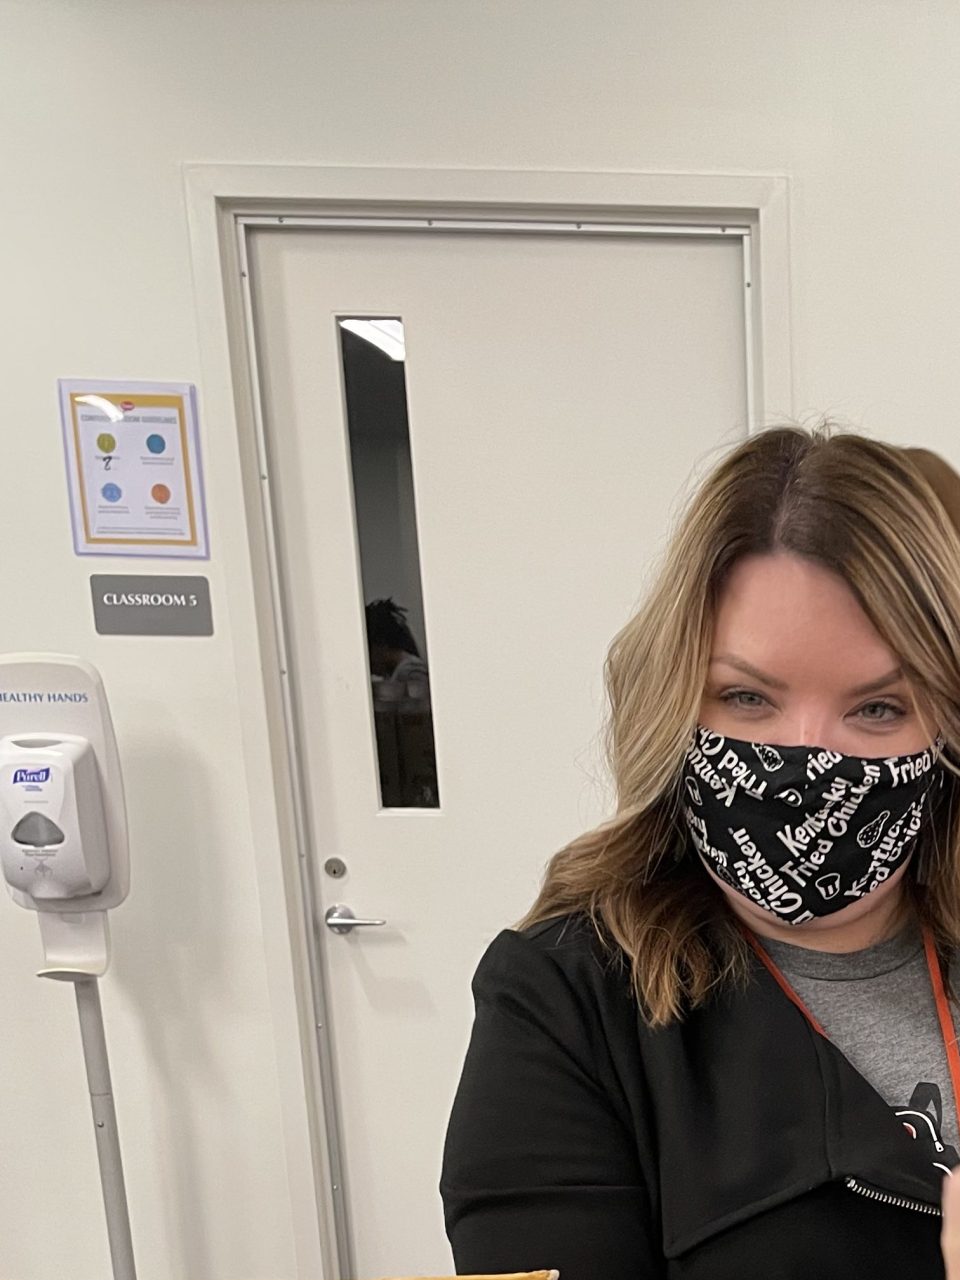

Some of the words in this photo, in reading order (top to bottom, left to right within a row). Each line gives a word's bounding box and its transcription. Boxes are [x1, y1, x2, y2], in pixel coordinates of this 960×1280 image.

[103, 593, 186, 606] CLASSROOM
[189, 594, 197, 607] 5
[48, 693, 88, 703] HANDS
[732, 827, 803, 915] Chicken
[779, 838, 834, 888] Fried
